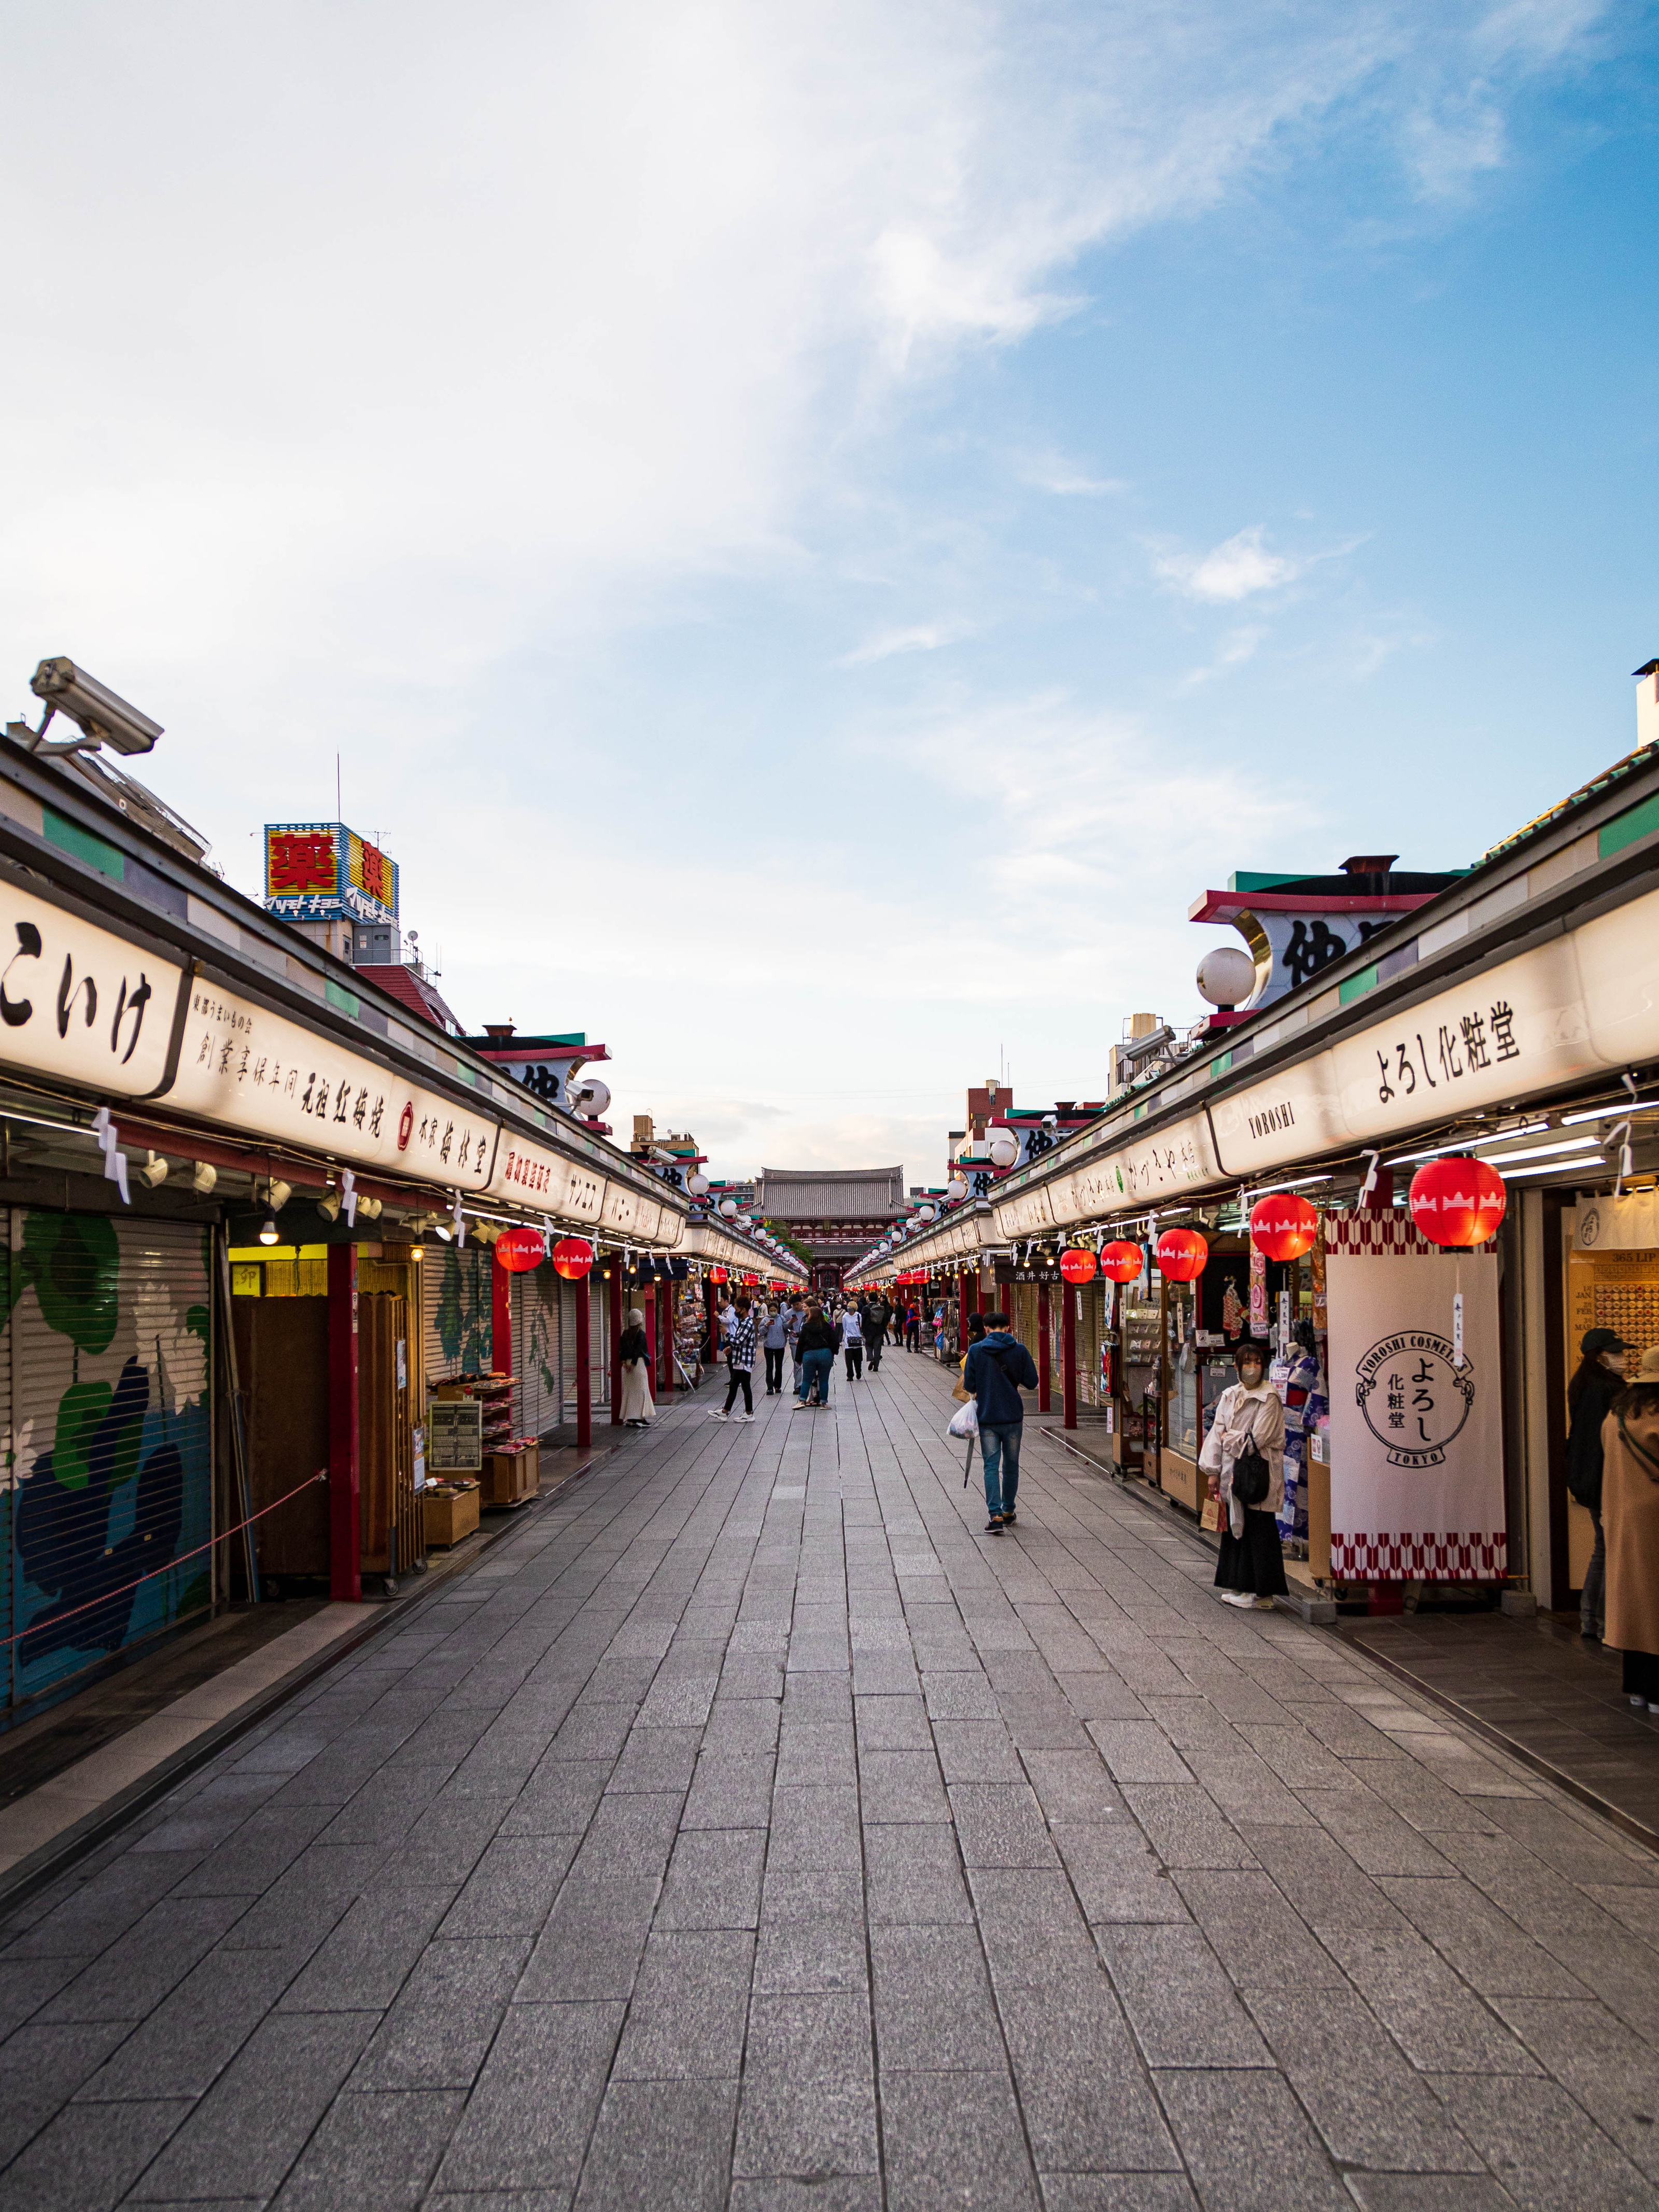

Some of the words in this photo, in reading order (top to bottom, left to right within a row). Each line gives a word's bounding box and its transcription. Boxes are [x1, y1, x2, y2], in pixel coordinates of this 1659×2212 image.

[271, 833, 333, 890] 薬
[361, 841, 384, 900] 薬
[263, 895, 343, 914] マツモトキヨシ
[0, 921, 151, 1065] こいけ
[193, 994, 252, 1035] 東都うまいもの会
[196, 1031, 298, 1100] 創業享保年間
[1377, 1001, 1520, 1104] よろし化粧堂
[1248, 1102, 1295, 1139] YOROSHI
[569, 1174, 596, 1212] サンエス
[1016, 1271, 1063, 1281] 酒井好古
[1612, 1253, 1633, 1262] 365
[1636, 1252, 1656, 1262] LIP
[1361, 1336, 1406, 1374] YOROSHI
[1410, 1335, 1468, 1373] COSMETS
[1387, 1373, 1405, 1429] 化粧堂
[1412, 1357, 1434, 1442] よろし
[1394, 1453, 1438, 1466] TOKYO
